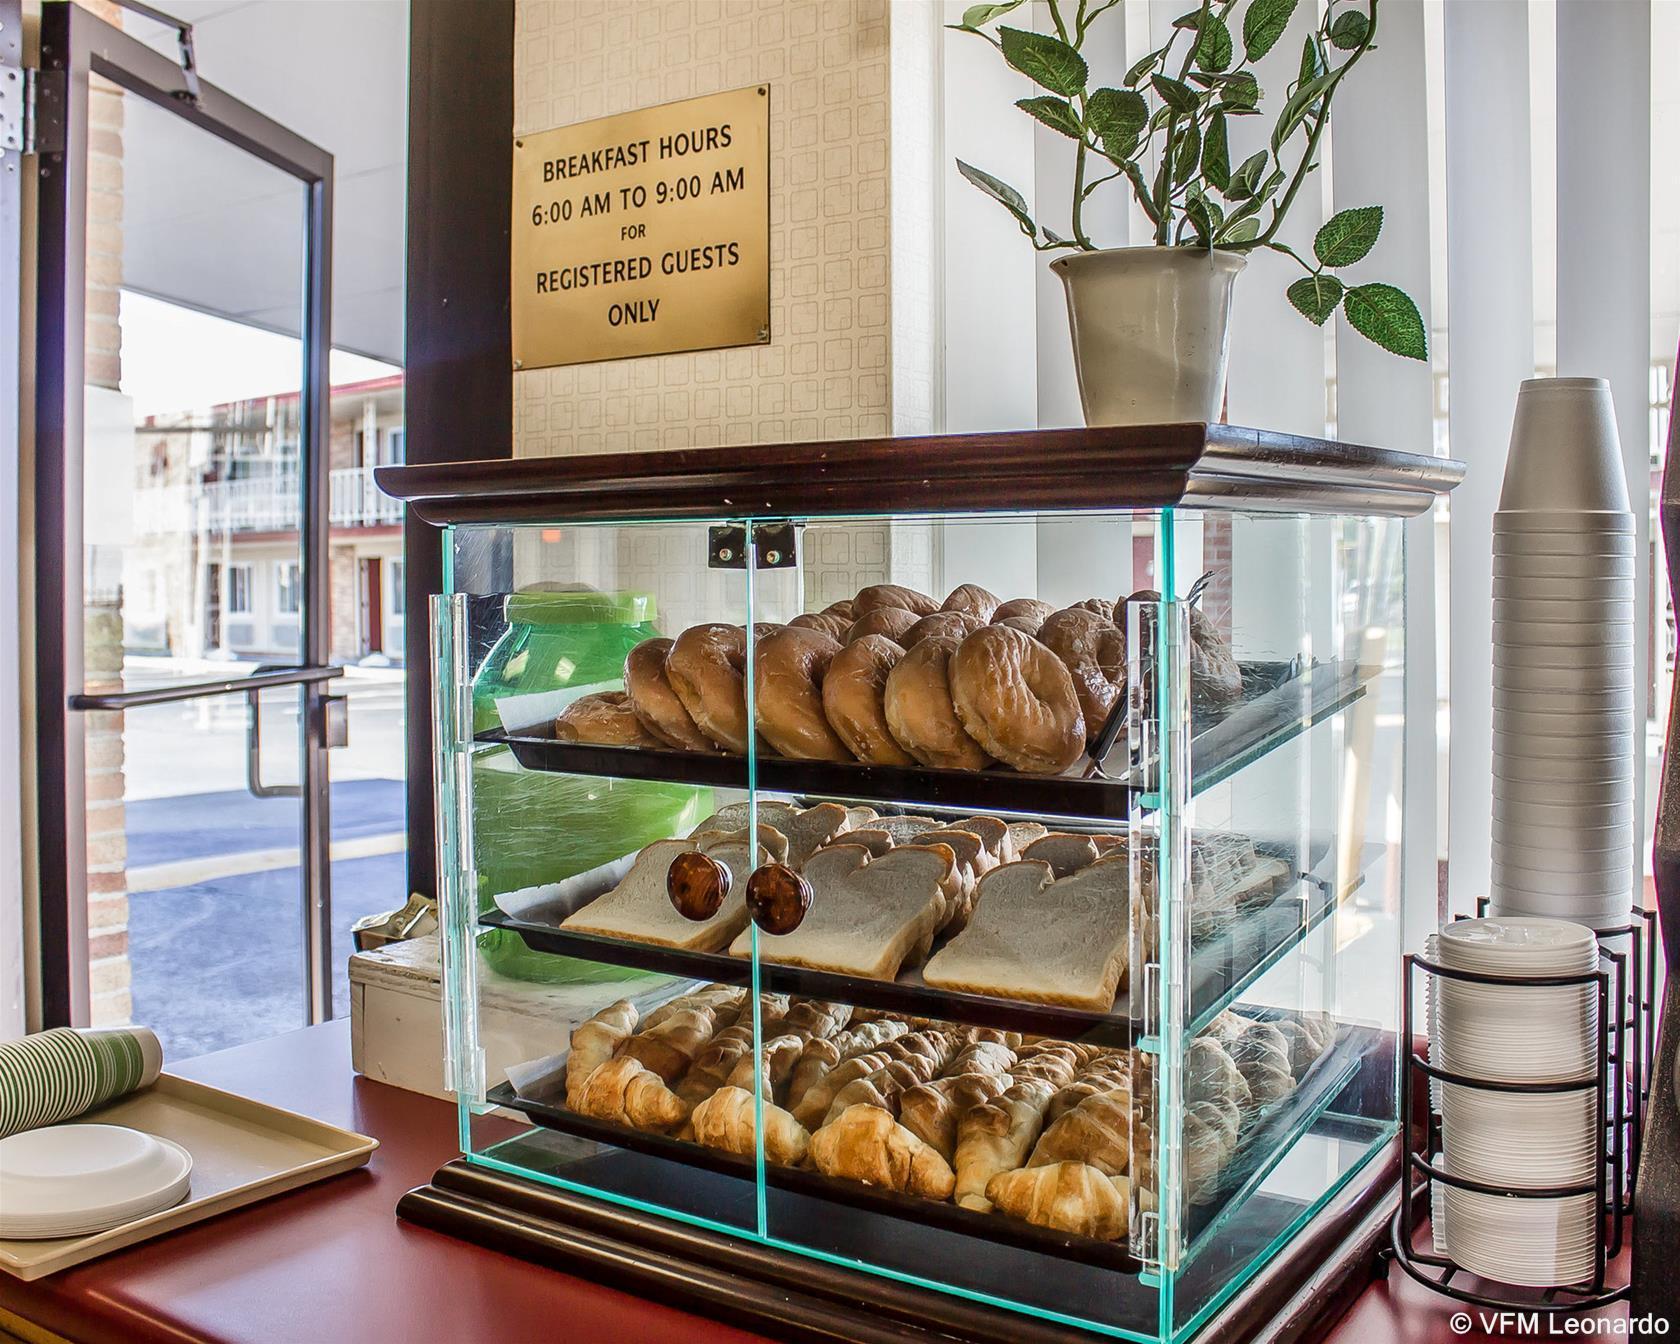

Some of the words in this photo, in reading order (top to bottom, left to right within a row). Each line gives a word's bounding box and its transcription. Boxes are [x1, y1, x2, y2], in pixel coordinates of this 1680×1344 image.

[543, 140, 650, 183] BREAKFAST
[659, 124, 732, 159] HOURS
[531, 199, 573, 226] 6:00
[580, 191, 611, 218] AM
[620, 185, 647, 210] TO
[656, 175, 701, 204] 9:00
[710, 167, 745, 195] AM
[620, 224, 646, 241] FOR
[536, 256, 651, 294] REGISTERED
[661, 242, 740, 275] GUESTS
[608, 299, 660, 327] ONLY
